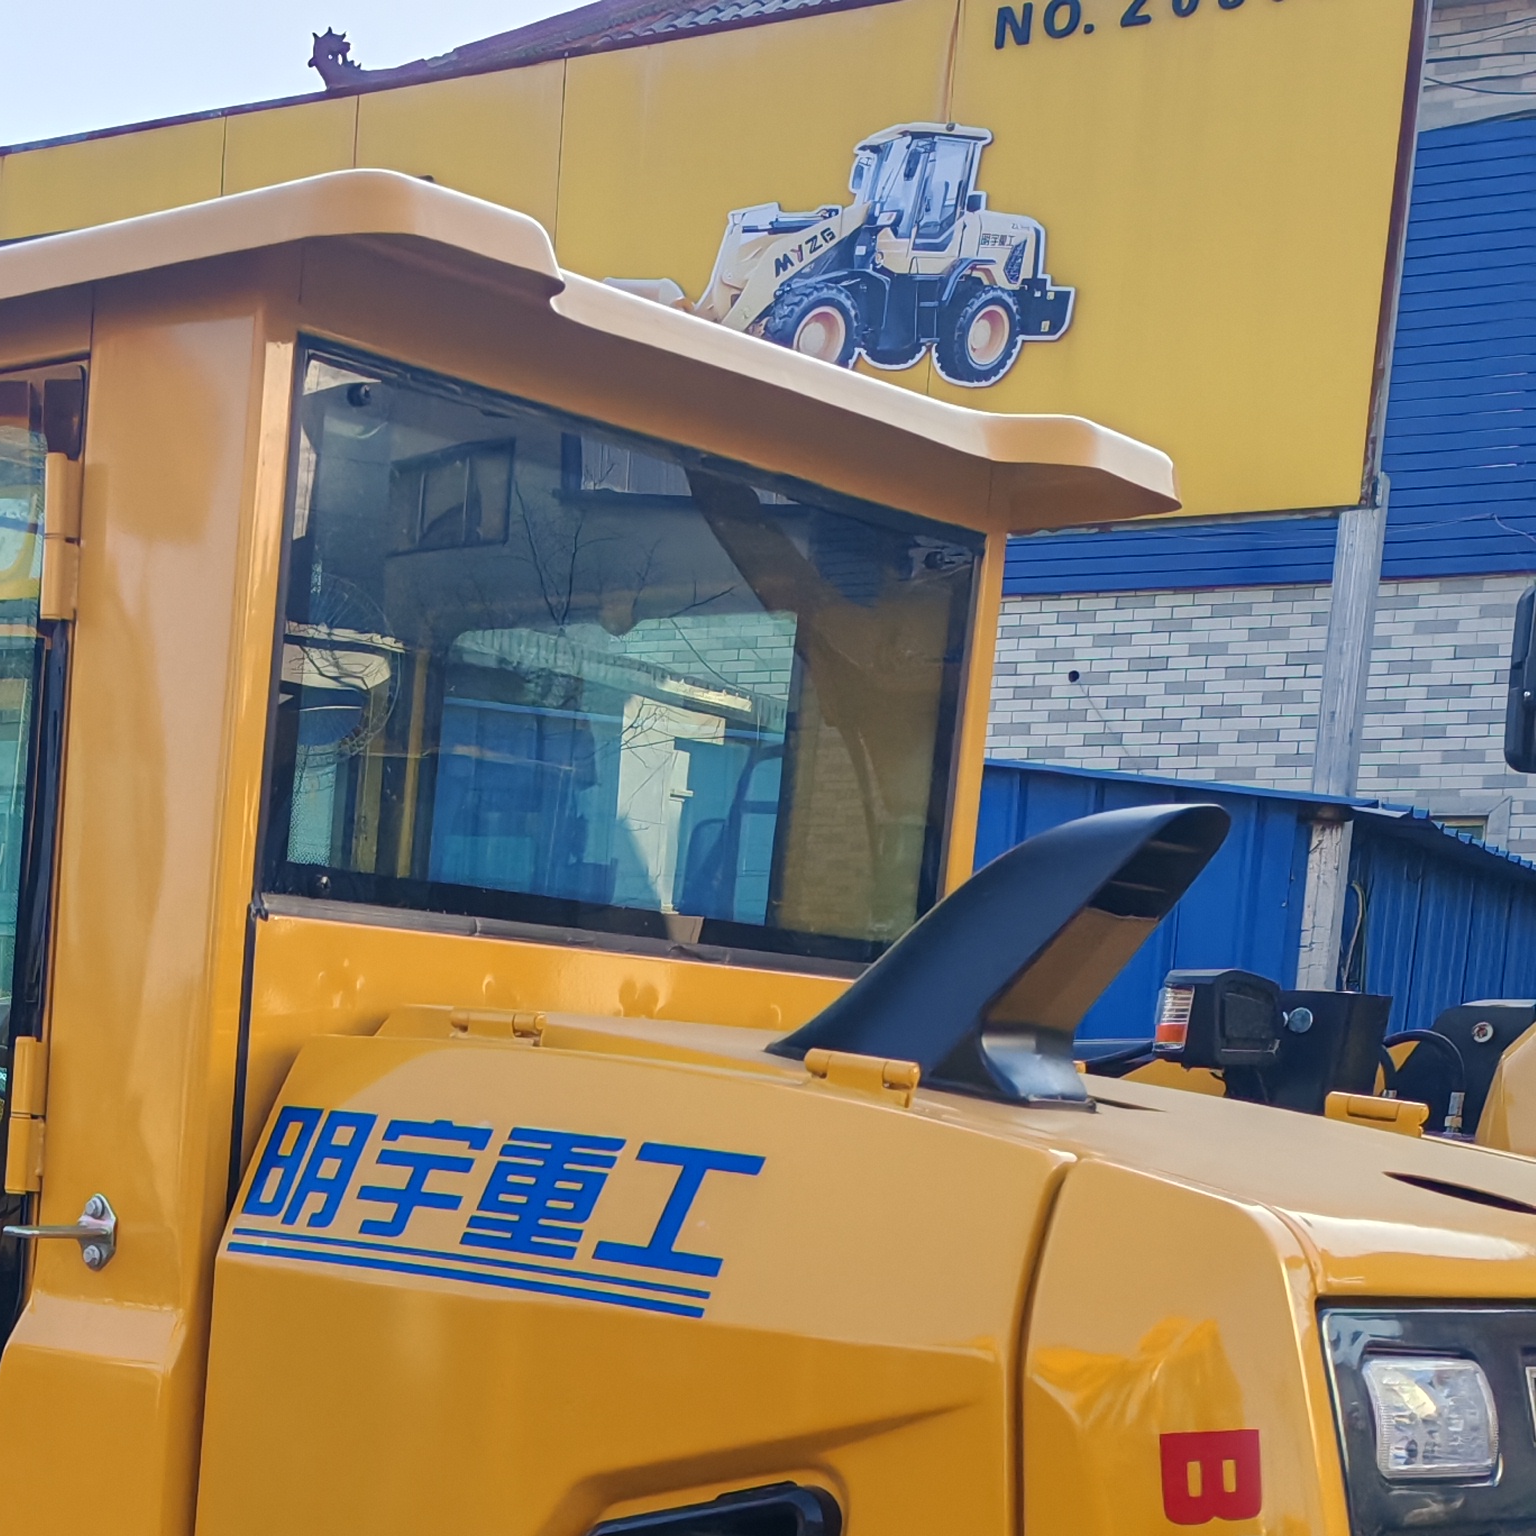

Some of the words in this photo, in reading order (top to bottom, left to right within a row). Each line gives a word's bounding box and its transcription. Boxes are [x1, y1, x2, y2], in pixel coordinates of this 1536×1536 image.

[994, 0, 1094, 49] NO.
[775, 227, 836, 278] MYZG
[241, 1105, 766, 1278] 明宇重工
